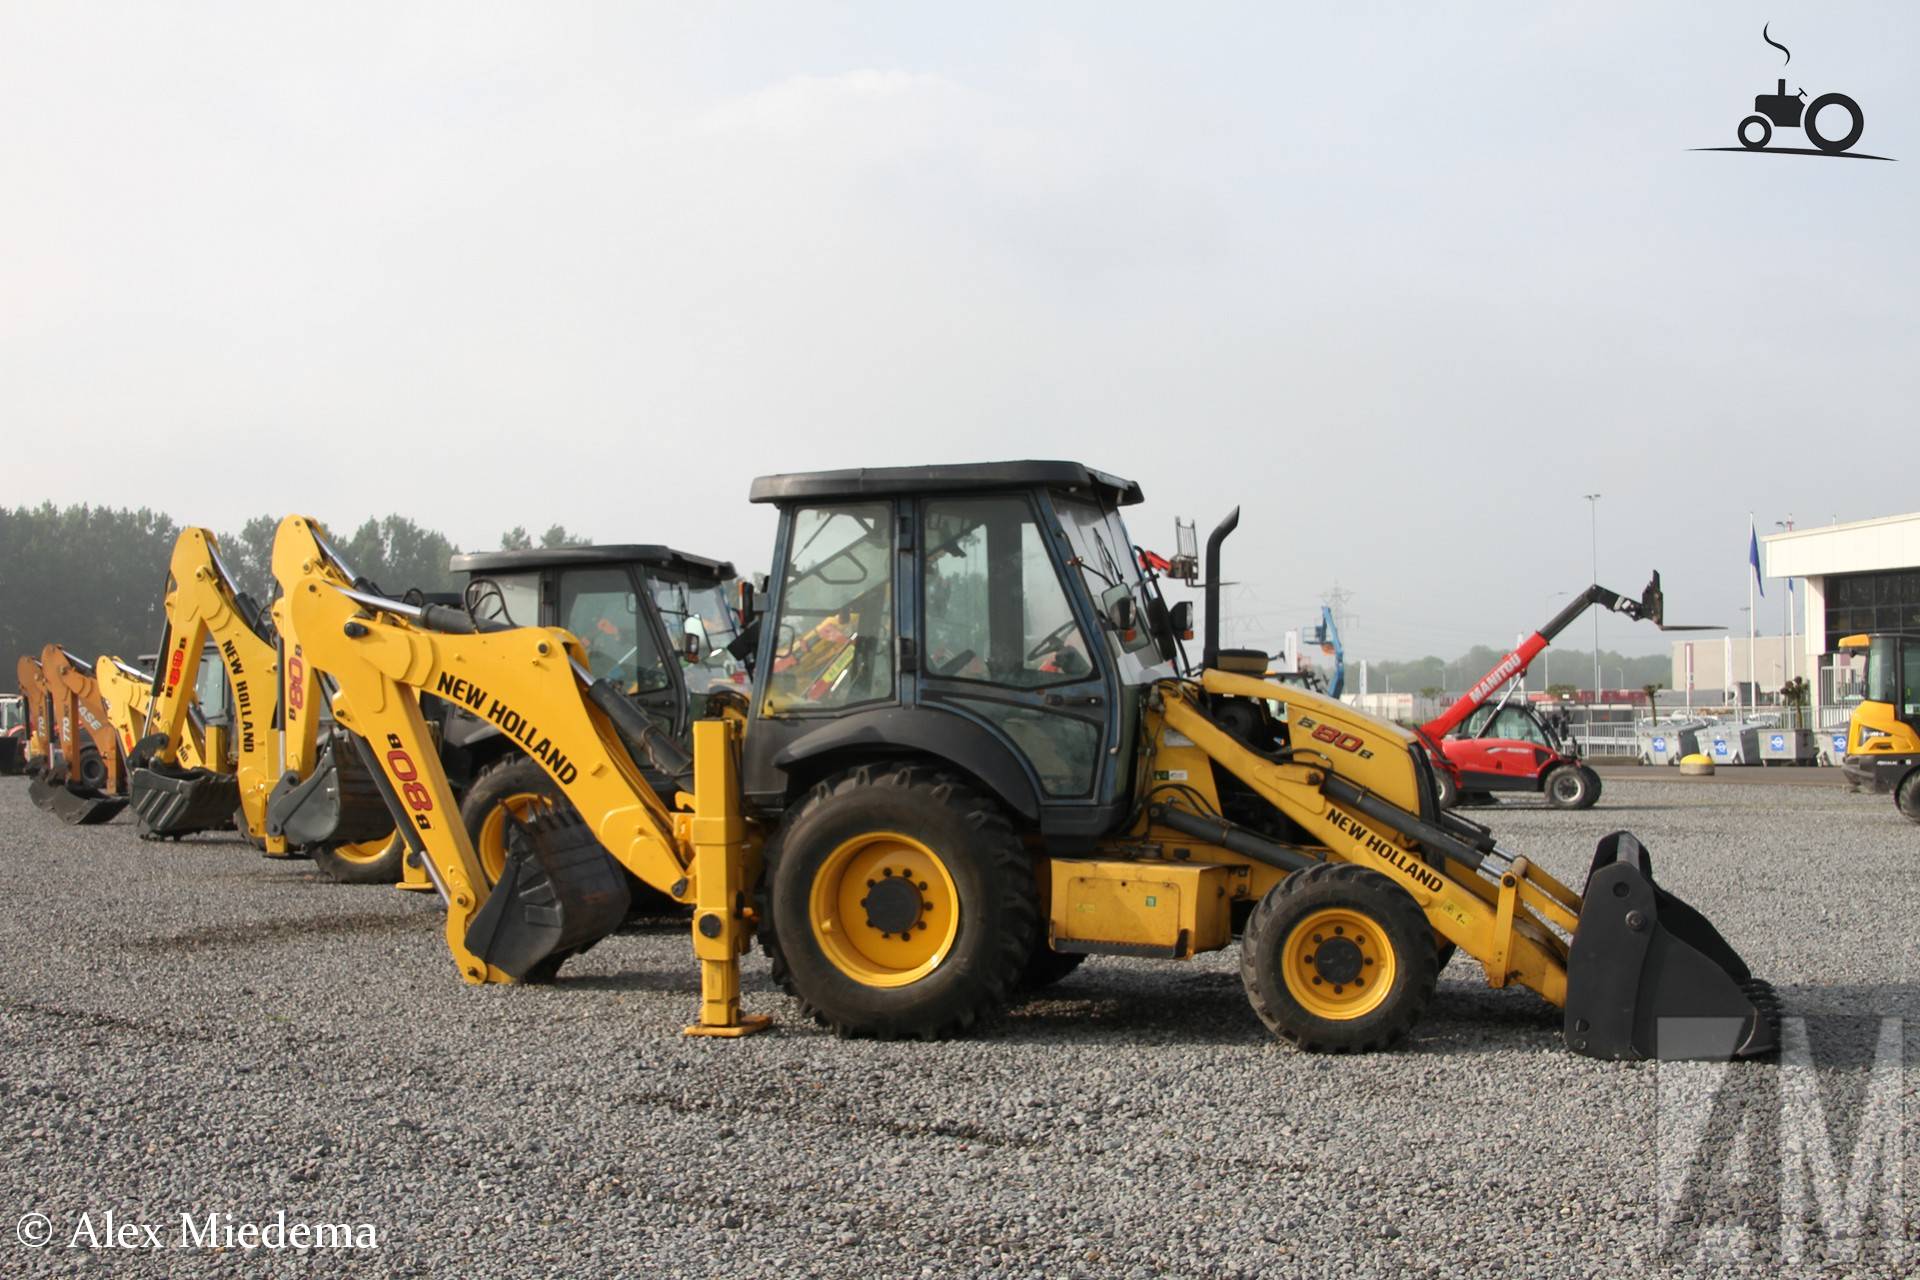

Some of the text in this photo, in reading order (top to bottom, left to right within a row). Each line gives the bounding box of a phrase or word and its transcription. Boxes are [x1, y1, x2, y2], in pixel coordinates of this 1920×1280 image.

[78, 698, 102, 730] ASE
[222, 639, 255, 753] NEW HOLLAND
[1470, 653, 1522, 703] MANITOU
[437, 671, 578, 785] NEW HOLLAND
[1326, 808, 1444, 893] NEW HOLLAND
